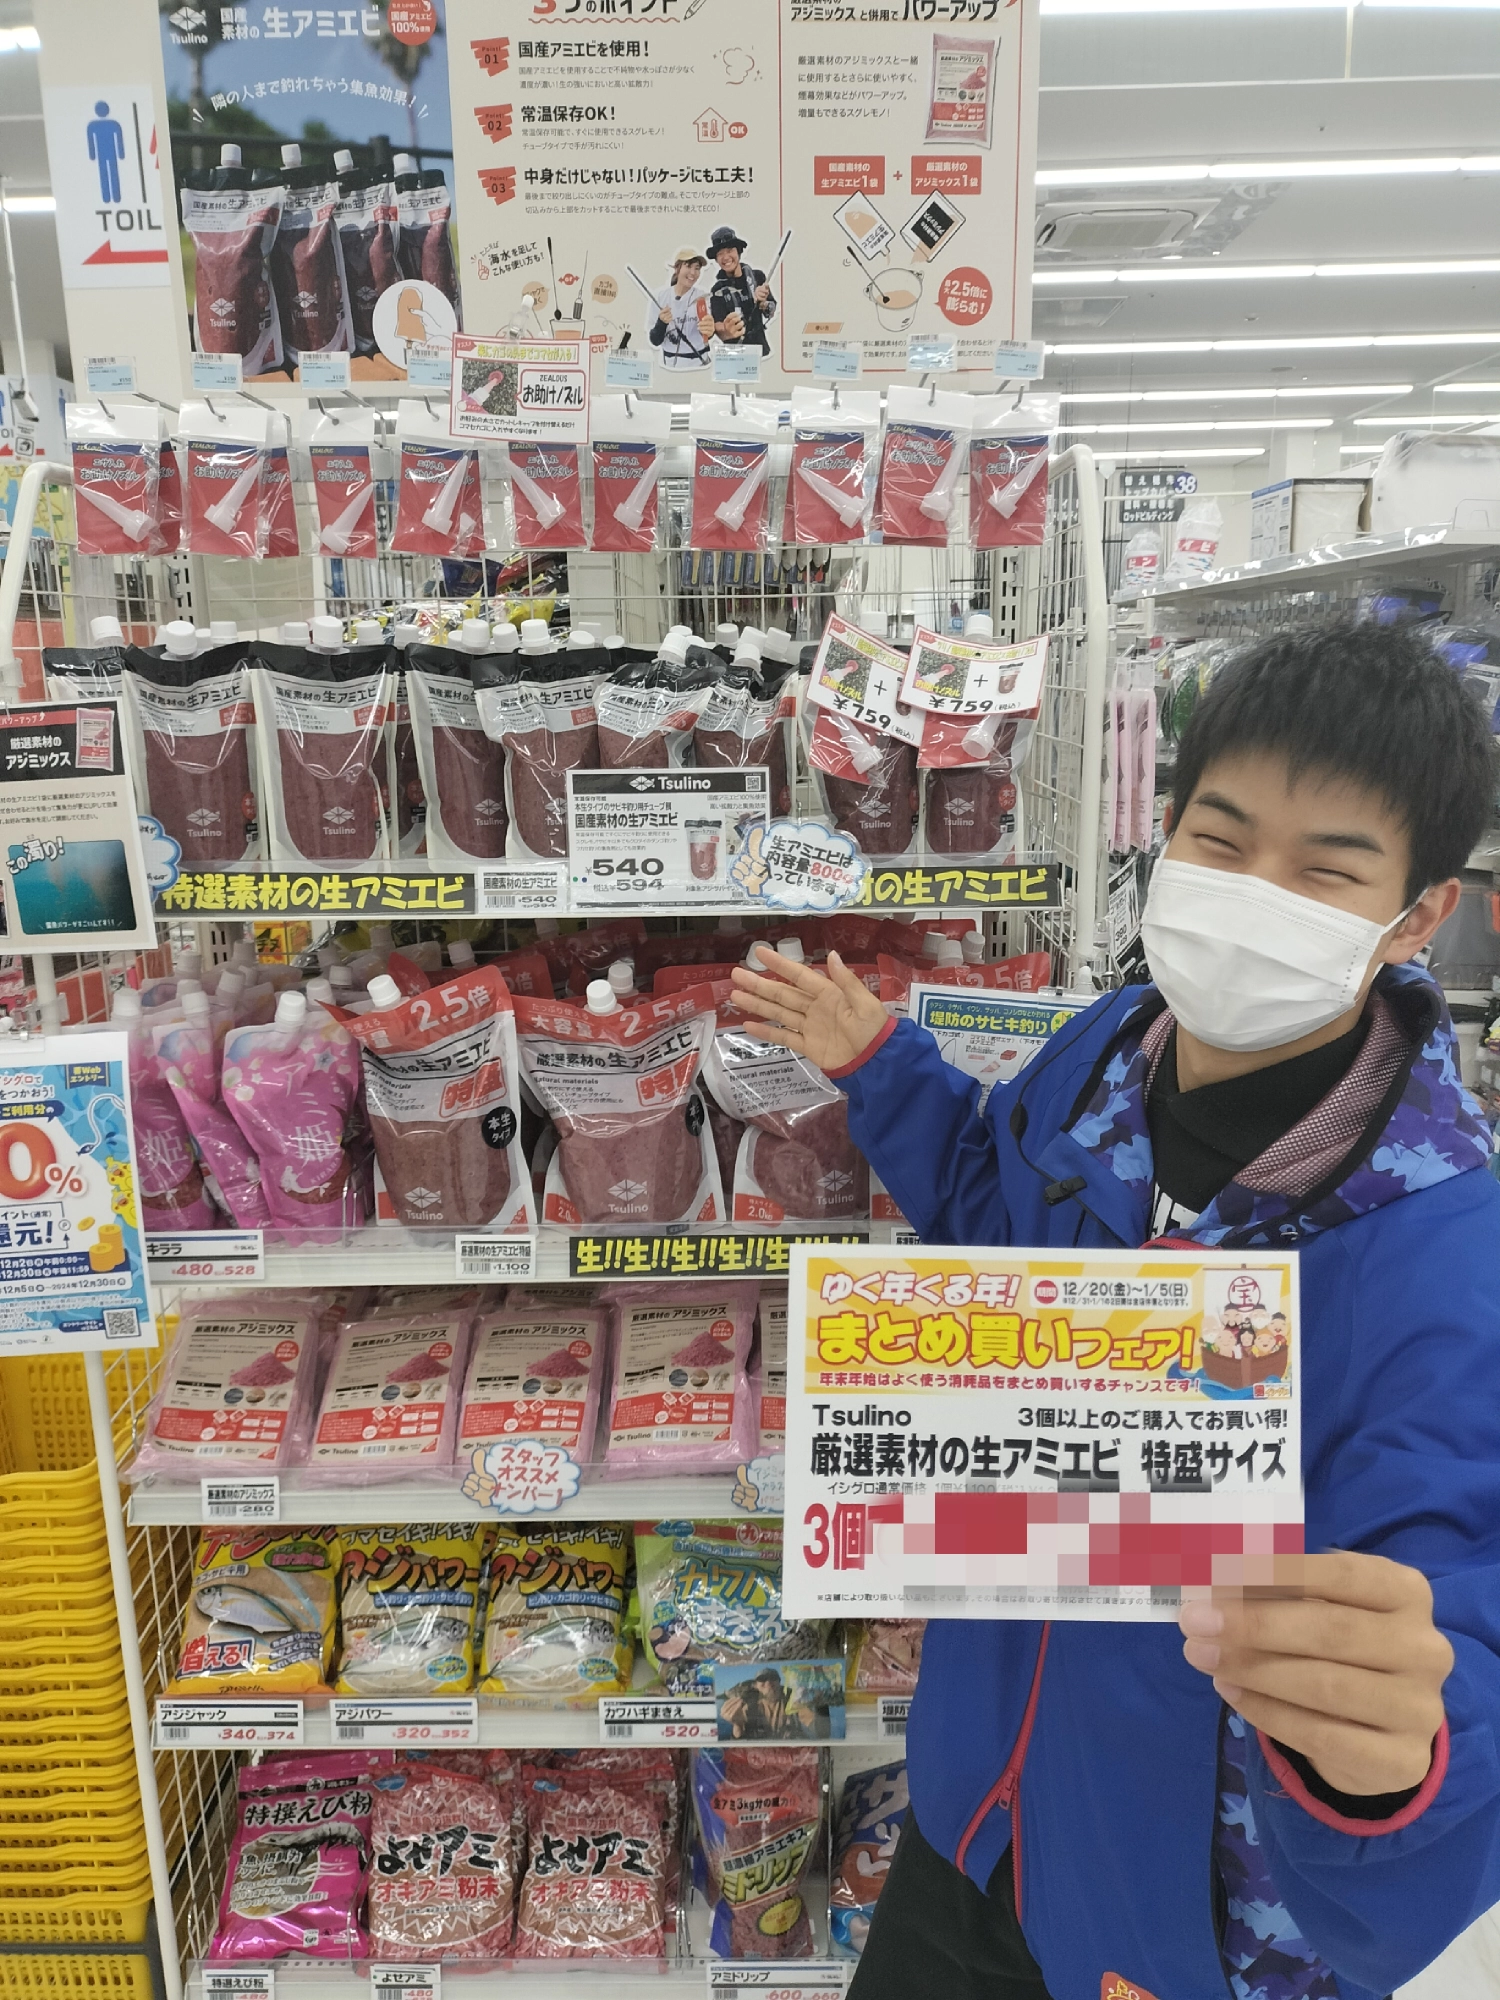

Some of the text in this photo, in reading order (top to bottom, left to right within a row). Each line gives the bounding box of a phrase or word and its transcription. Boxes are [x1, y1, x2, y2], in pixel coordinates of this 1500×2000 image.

[220, 7, 247, 23] 国産
[263, 5, 380, 38] 生アミエビ
[170, 33, 208, 44] Tsulino
[221, 24, 260, 40] 素材の
[518, 41, 650, 58] 国産アミエビを使用!
[484, 54, 499, 64] 01
[798, 55, 919, 66] 厳選素材のアジミックスと一緒
[210, 77, 417, 111] 隣の人まで釣れちゃう集魚効果!
[521, 106, 616, 123] 常温保存OK!
[487, 120, 503, 131] 02
[524, 166, 754, 184] 中身だけじゃない!パッケージにも工夫!
[491, 183, 506, 193] 03
[522, 384, 583, 405] お助けノズル
[1174, 475, 1197, 493] 38
[929, 695, 993, 713] ¥759
[5, 752, 71, 770] アジミックス
[658, 776, 711, 790] Tsulino
[575, 812, 679, 829] 国産素材の生アミエビ
[859, 820, 892, 830] Tsulino
[943, 817, 975, 826] Tsulino
[186, 828, 222, 838] Tsulino
[322, 826, 356, 836] Tsulino
[769, 835, 854, 868] 生アミエビは
[585, 857, 664, 876] ¥540
[410, 984, 491, 1032] 2.5倍
[930, 1012, 1048, 1035] 堤防のサビキ釣り
[608, 1203, 649, 1214] Tsulino
[816, 1194, 854, 1205] Tsulino
[406, 1209, 444, 1221] Tsulino
[821, 1271, 1022, 1309] ゆく年くる年!
[818, 1311, 1195, 1370] まとめ買いフェア!
[820, 1372, 1200, 1392] 年末年始はよく使う消耗品をまとめ買いするチャンスです!
[812, 1404, 1288, 1430] Tsulino 3個以上のご購入でお買い得!
[501, 1447, 561, 1468] スタッフ
[811, 1432, 1286, 1484] 厳選素材の生アミエビ 特盛サイズ
[497, 1466, 560, 1485] オススメ
[803, 1501, 867, 1570] 3個
[343, 1545, 479, 1593] アジパワー
[492, 1545, 623, 1594] アジパワー
[161, 1709, 227, 1720] アジジャック
[335, 1708, 393, 1720] アジパワー
[605, 1706, 685, 1718] カワハギまきえ
[245, 1791, 373, 1826] 特撰えび粉
[377, 1824, 502, 1878] よせアミ
[376, 1877, 501, 1904] オキアミ粉末
[532, 1879, 652, 1904] オキアミ粉末
[382, 1973, 427, 1983] よせアミ
[711, 1971, 771, 1982] アミドリップ
